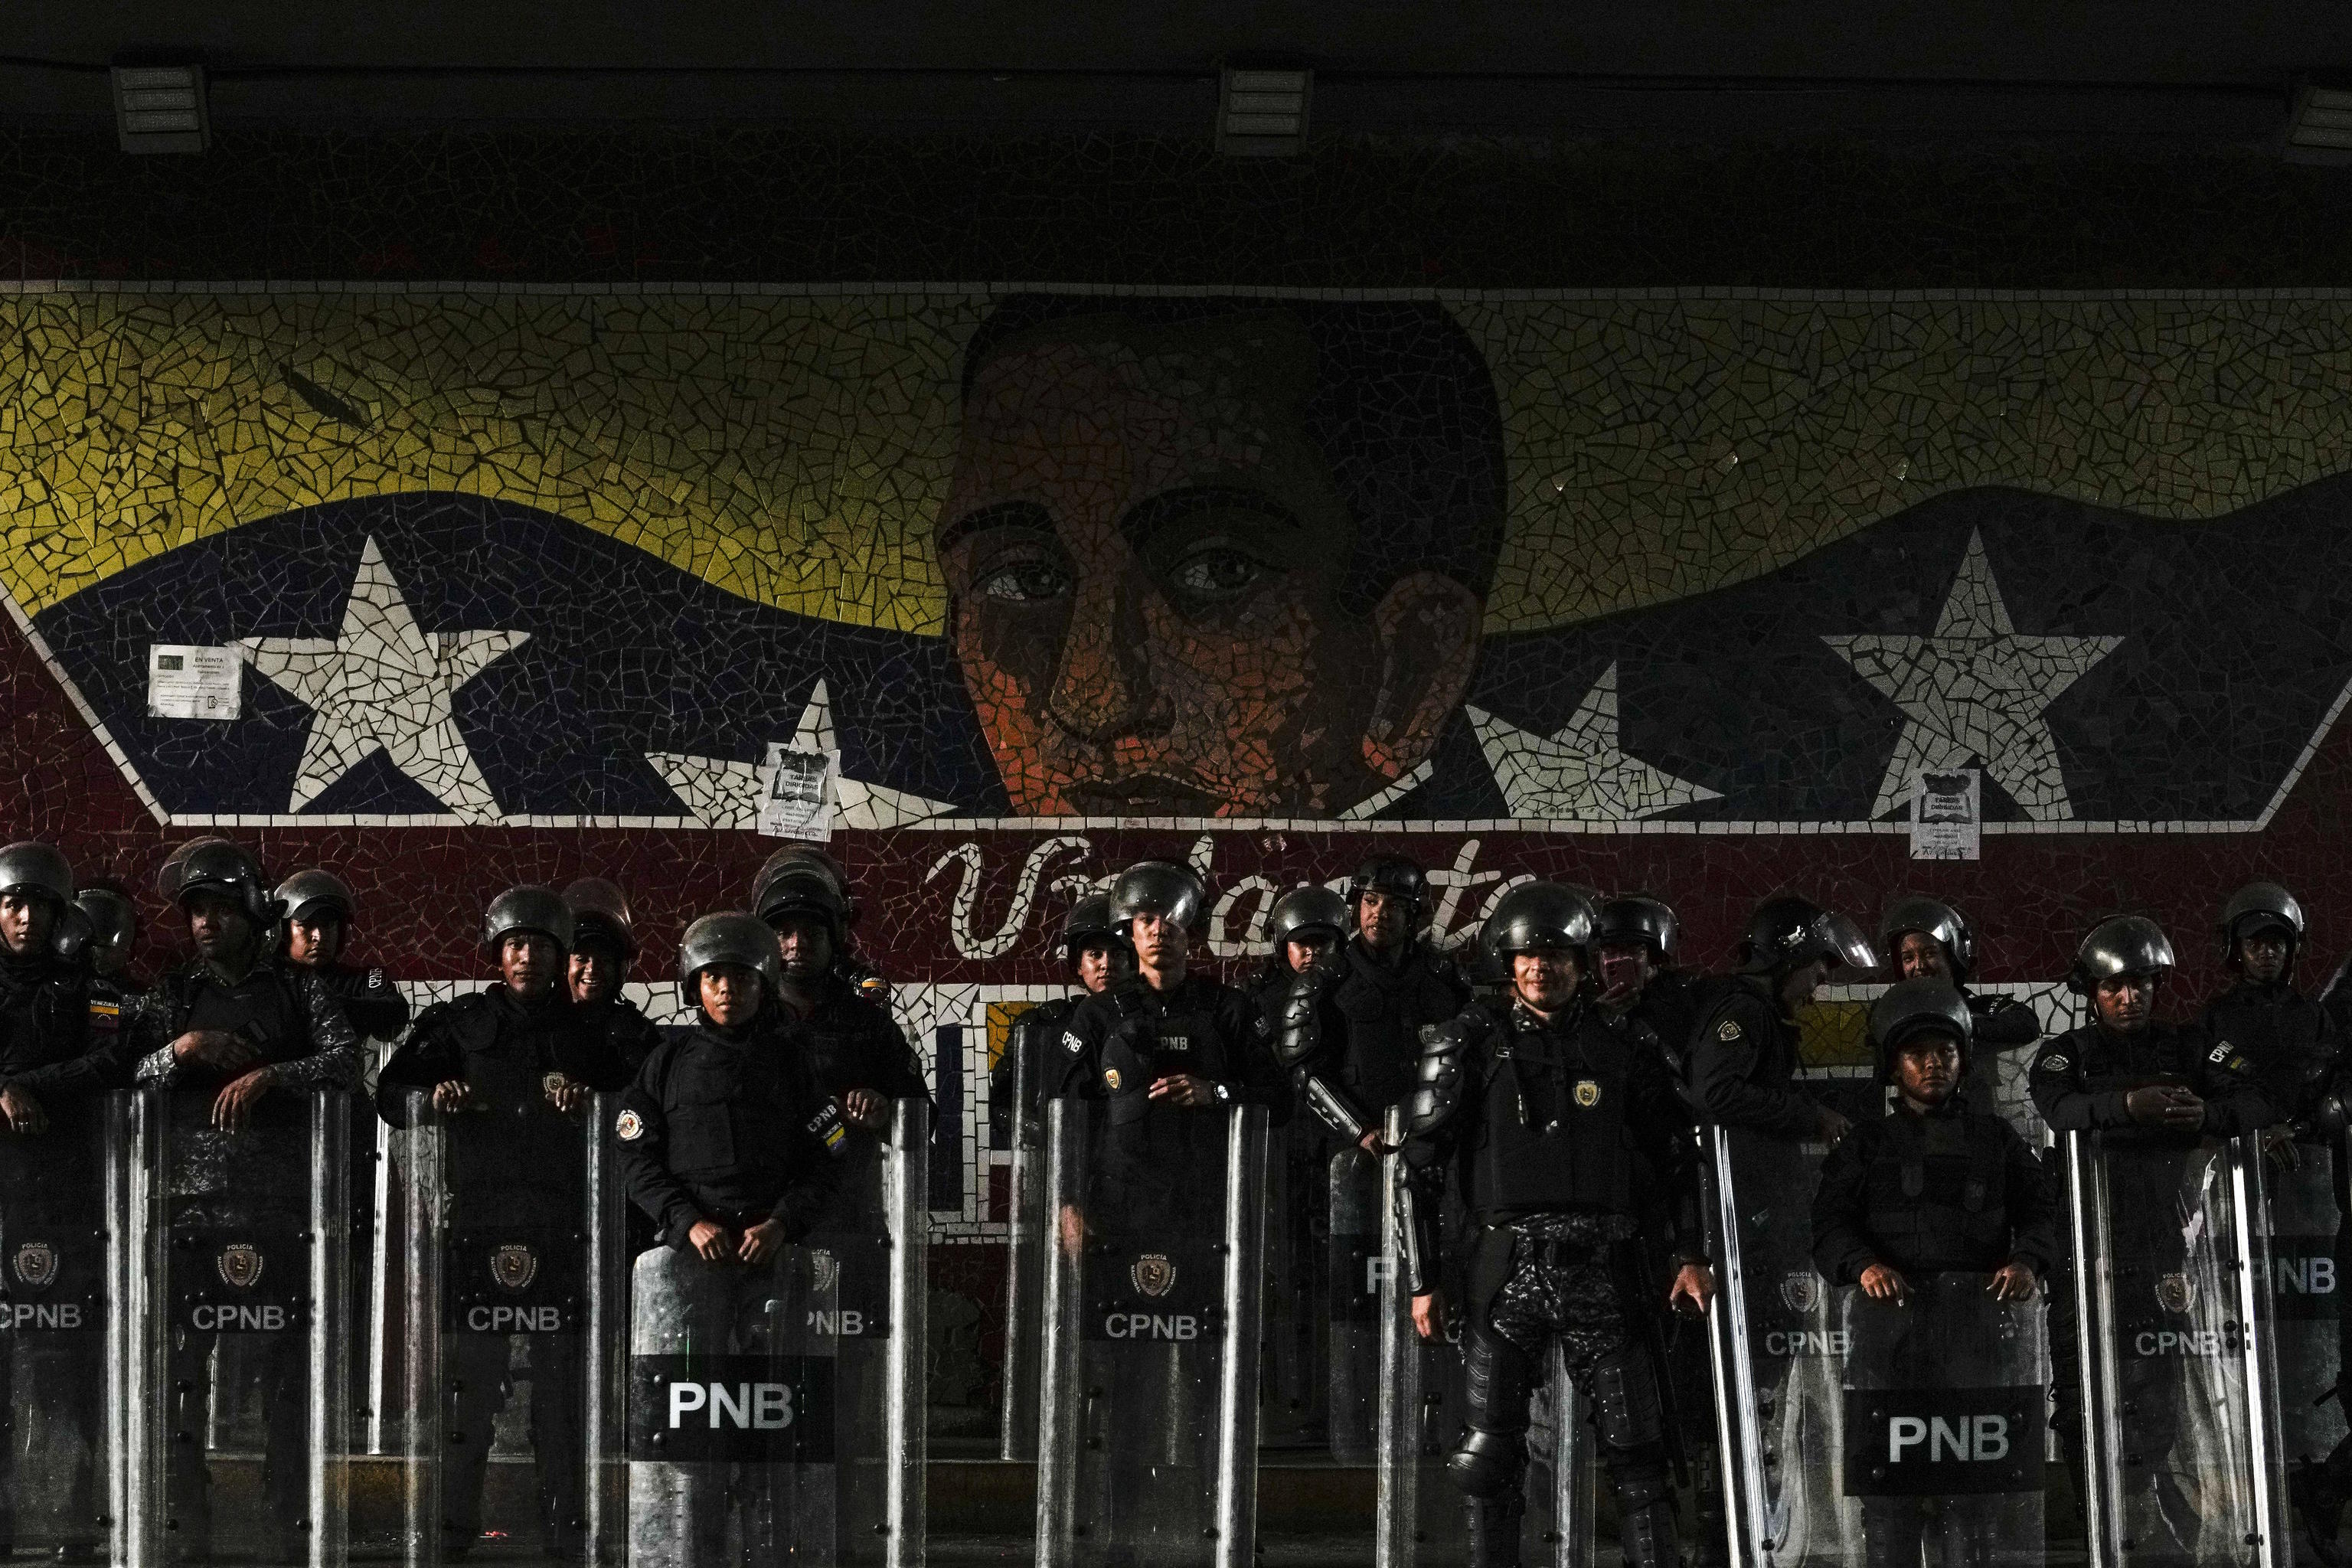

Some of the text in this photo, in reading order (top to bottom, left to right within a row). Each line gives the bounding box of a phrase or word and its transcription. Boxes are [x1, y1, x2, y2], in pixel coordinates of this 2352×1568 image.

[1062, 1031, 1083, 1053] CPNB
[807, 1104, 837, 1132] CPNB
[0, 1303, 83, 1328] CPNB
[192, 1304, 286, 1331] CPNB
[468, 1305, 561, 1331] CPNB
[1105, 1312, 1198, 1341] CPNB
[2135, 1331, 2221, 1357] CPNB
[669, 1382, 794, 1429] PNB
[1889, 1414, 2010, 1463] PNB
